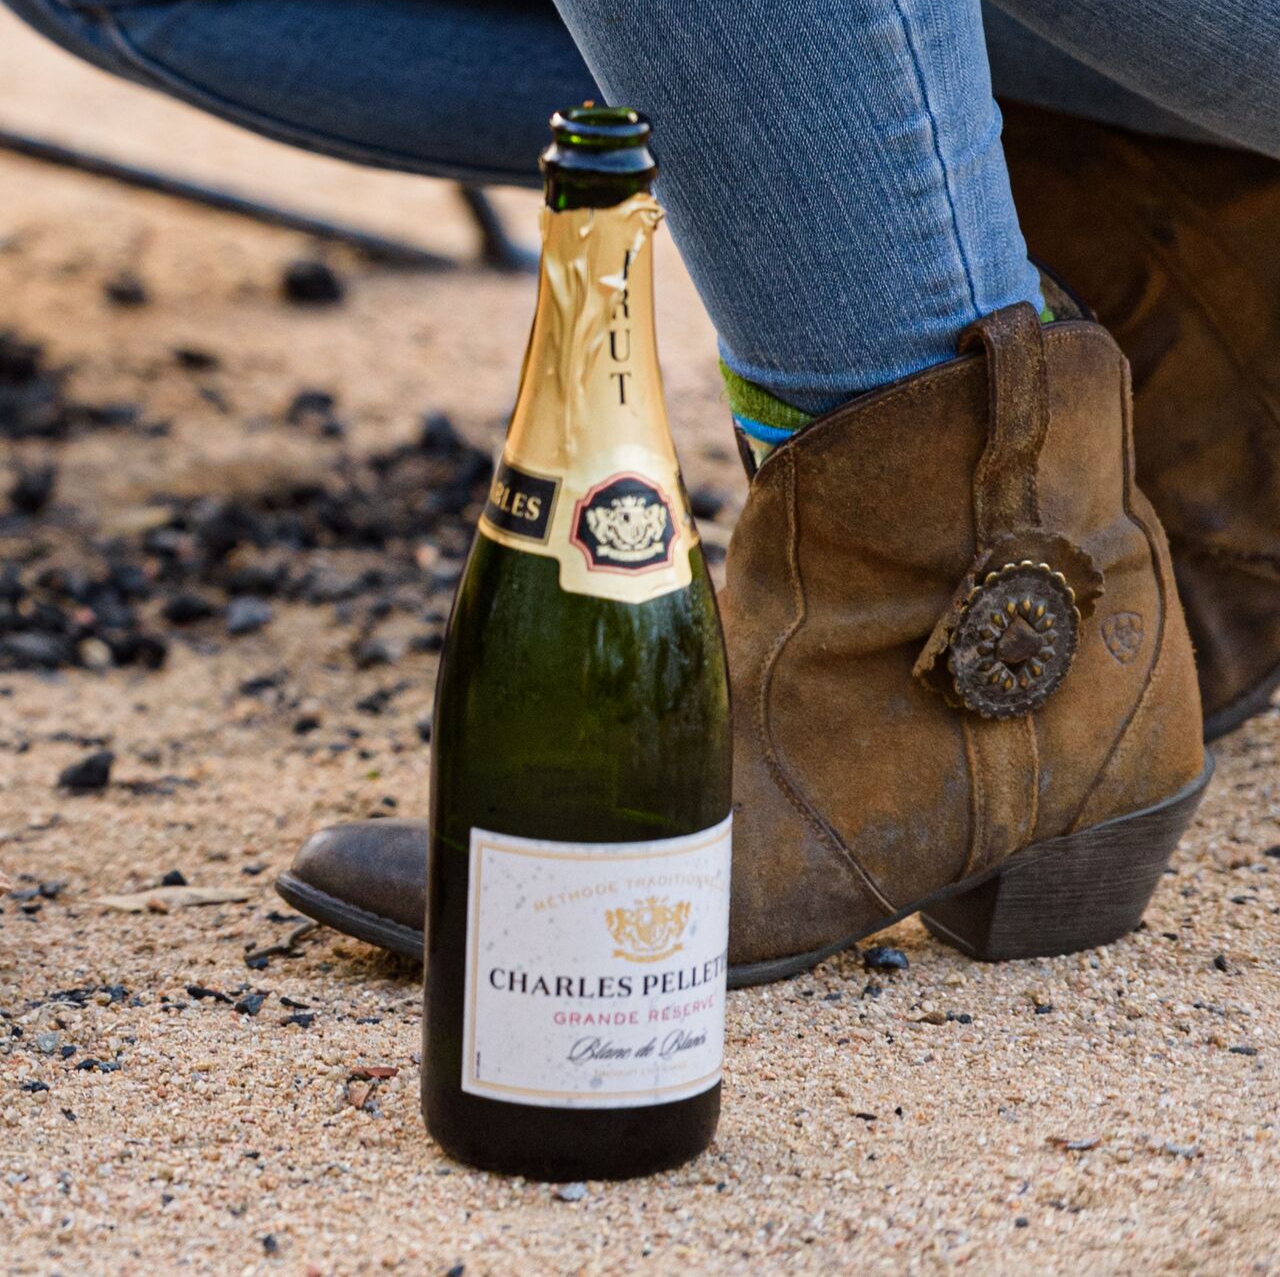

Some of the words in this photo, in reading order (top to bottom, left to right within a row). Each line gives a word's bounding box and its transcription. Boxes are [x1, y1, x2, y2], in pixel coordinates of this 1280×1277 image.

[489, 966, 633, 999] CHARLES
[553, 1010, 640, 1026] GRANDE
[648, 993, 716, 1022] RÉSERVE
[566, 1035, 632, 1066] Blanc
[633, 1036, 658, 1059] de
